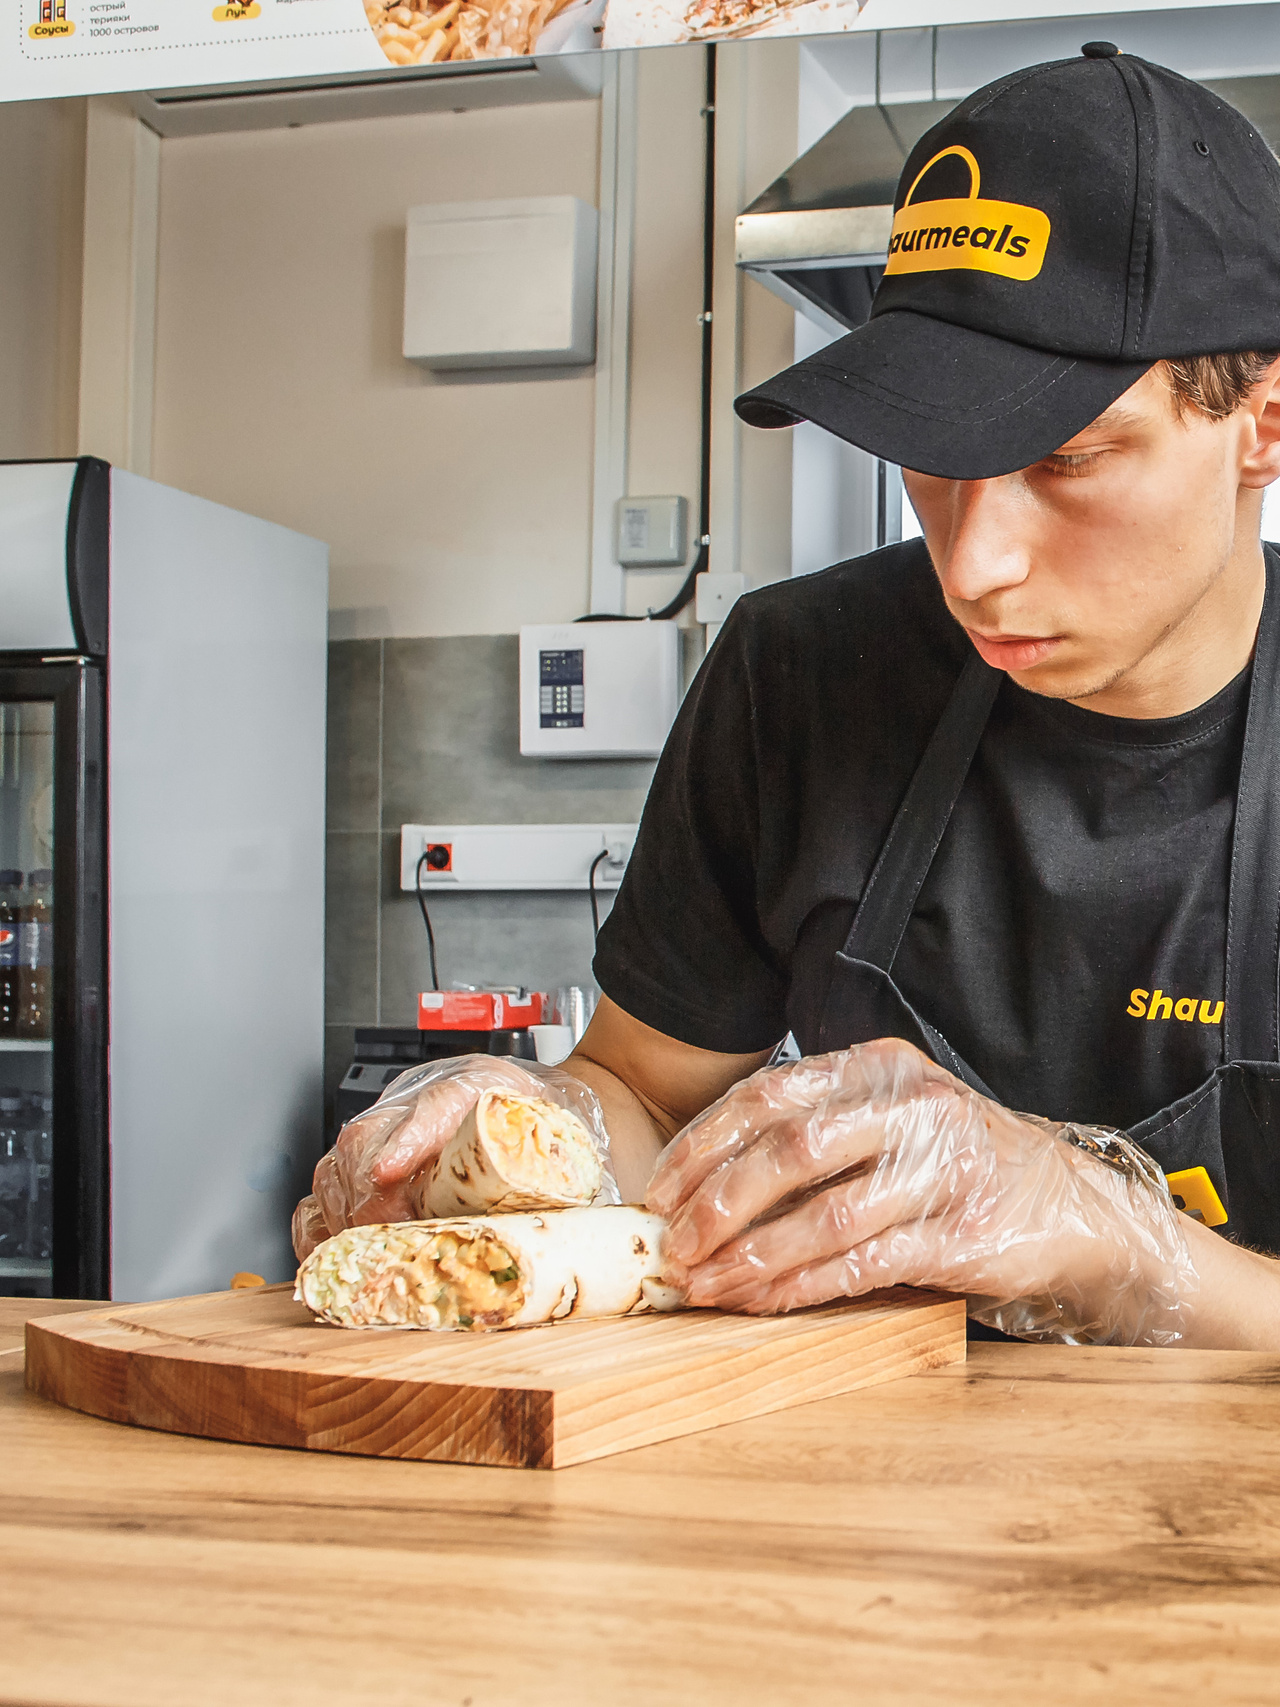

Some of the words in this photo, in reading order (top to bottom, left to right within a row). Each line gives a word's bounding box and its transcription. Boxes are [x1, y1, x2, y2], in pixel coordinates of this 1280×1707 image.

[90, 1, 126, 13] острый
[225, 8, 247, 19] Лук
[90, 15, 131, 26] терияки
[34, 25, 69, 37] Соусы
[90, 27, 112, 37] 1000
[114, 24, 160, 36] островов
[888, 224, 1031, 258] aurmeals
